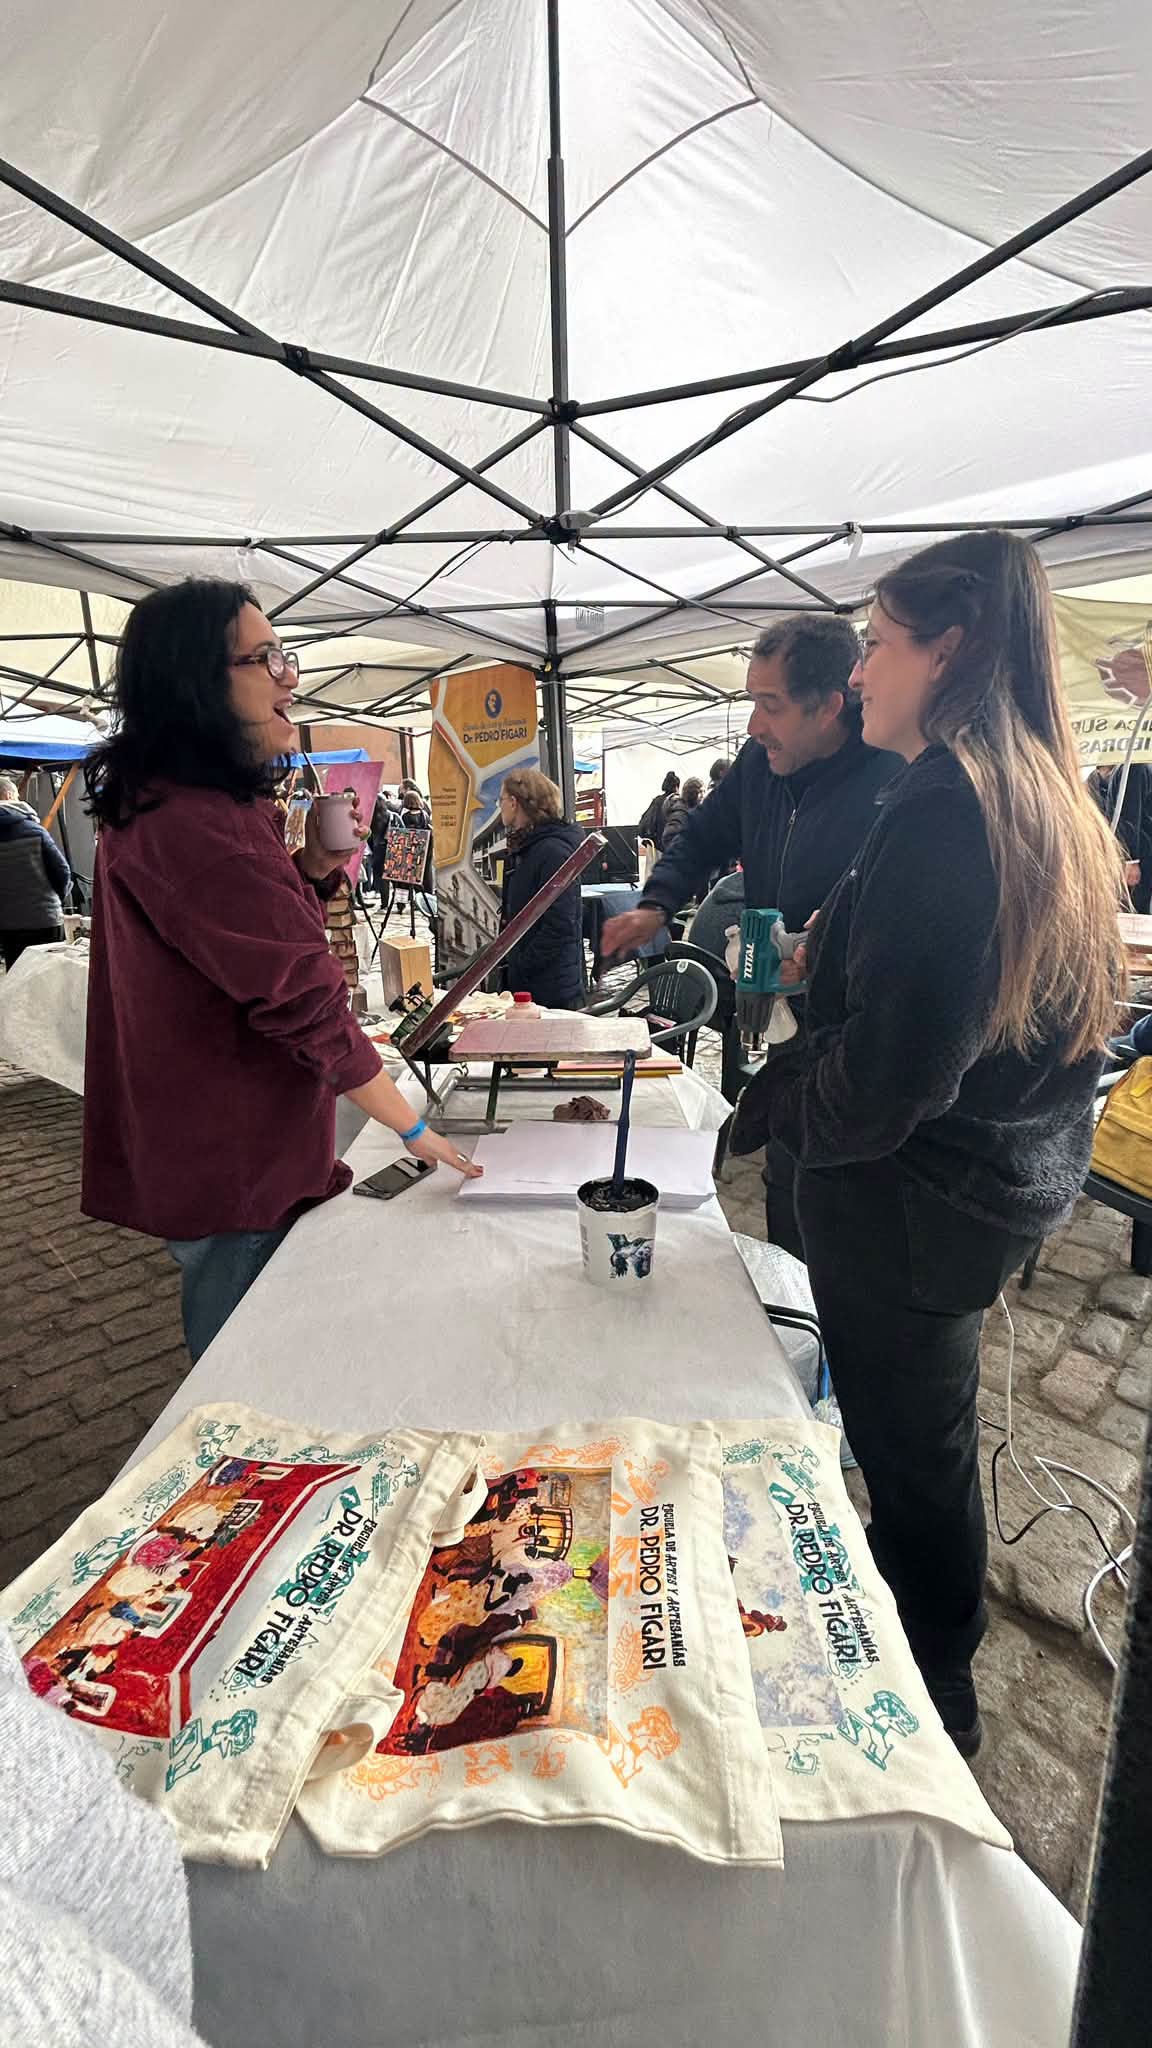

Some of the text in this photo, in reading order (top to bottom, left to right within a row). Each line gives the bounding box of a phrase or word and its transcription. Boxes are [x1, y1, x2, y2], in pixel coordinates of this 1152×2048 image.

[475, 730, 499, 743] PEDRO
[501, 727, 527, 741] FIGARI
[743, 943, 755, 979] TOTAL
[348, 1518, 378, 1560] ESCUELA
[338, 1558, 351, 1574] DE
[661, 1503, 688, 1667] ESCUELA DE ARTES Y ARTESANÍAS
[785, 1503, 862, 1664] DR. PEDRO FIGARI
[807, 1502, 880, 1663] ESCUELA DE ARTES Y ARTESANÍAS
[234, 1508, 363, 1679] DR. PEDRO FIGARI
[317, 1571, 343, 1606] ARTES
[639, 1505, 668, 1670] DR. PEDRO FIGARI
[308, 1606, 322, 1616] Y
